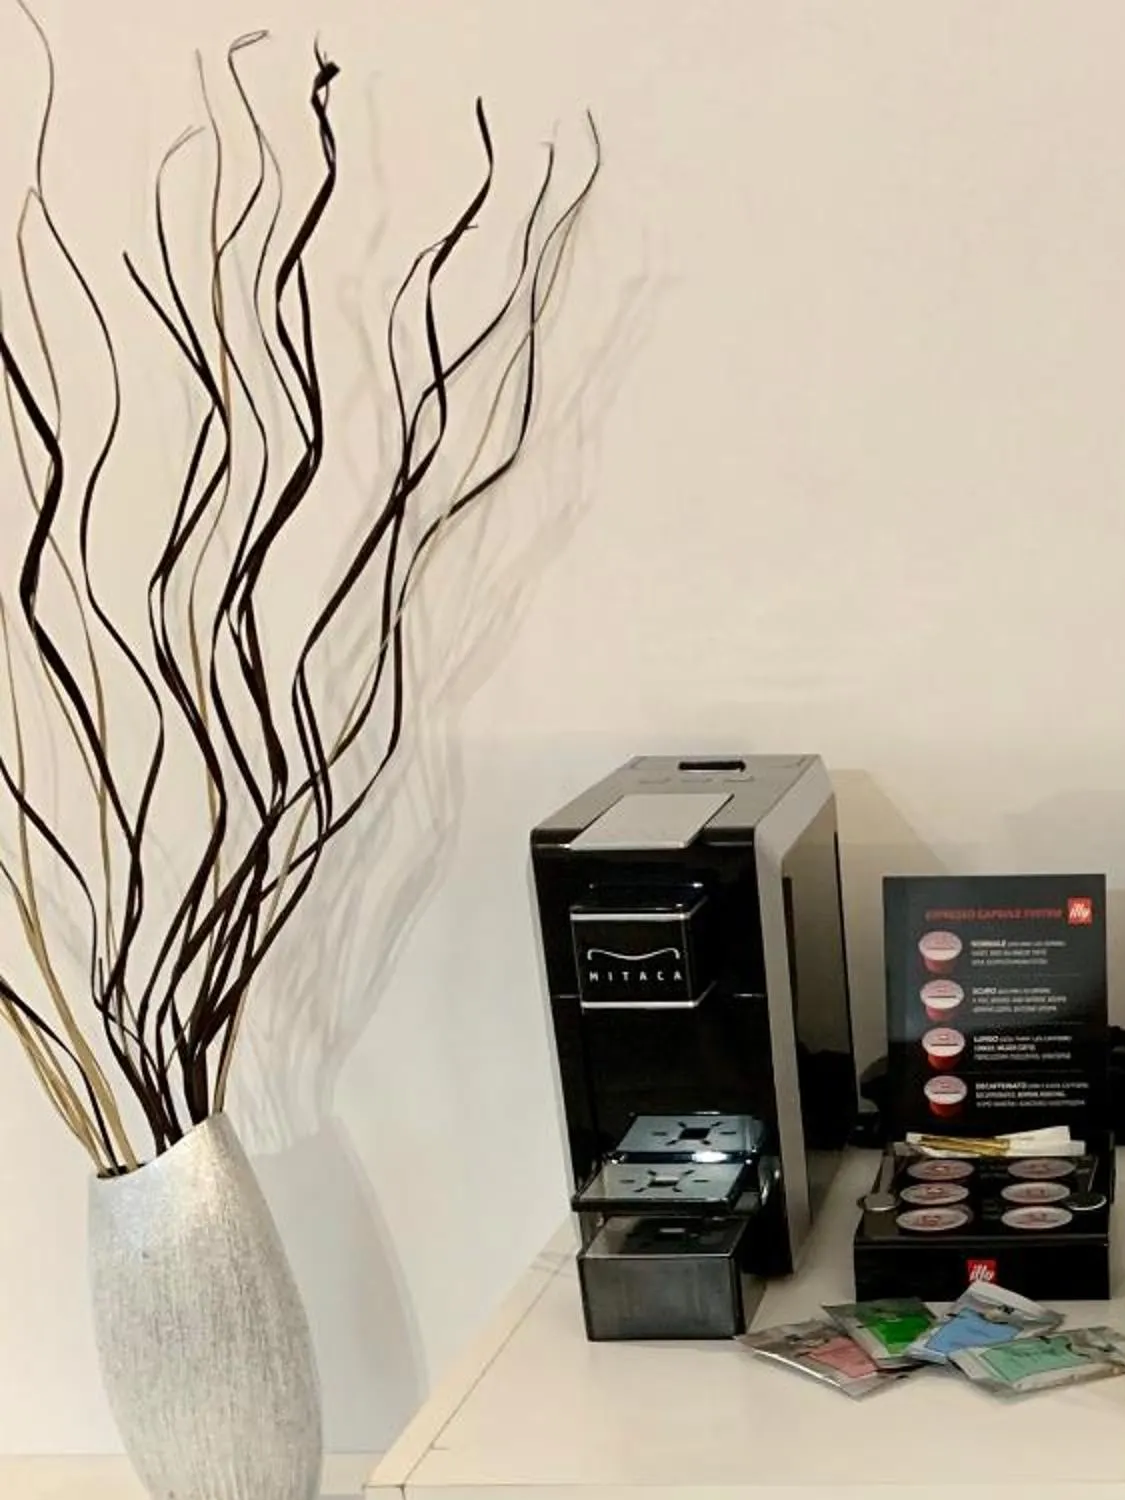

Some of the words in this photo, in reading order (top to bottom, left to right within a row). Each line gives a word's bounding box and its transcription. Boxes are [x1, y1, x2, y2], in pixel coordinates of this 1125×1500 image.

[1069, 902, 1091, 920] illy
[589, 970, 682, 982] MITACA
[969, 1263, 995, 1281] illy
